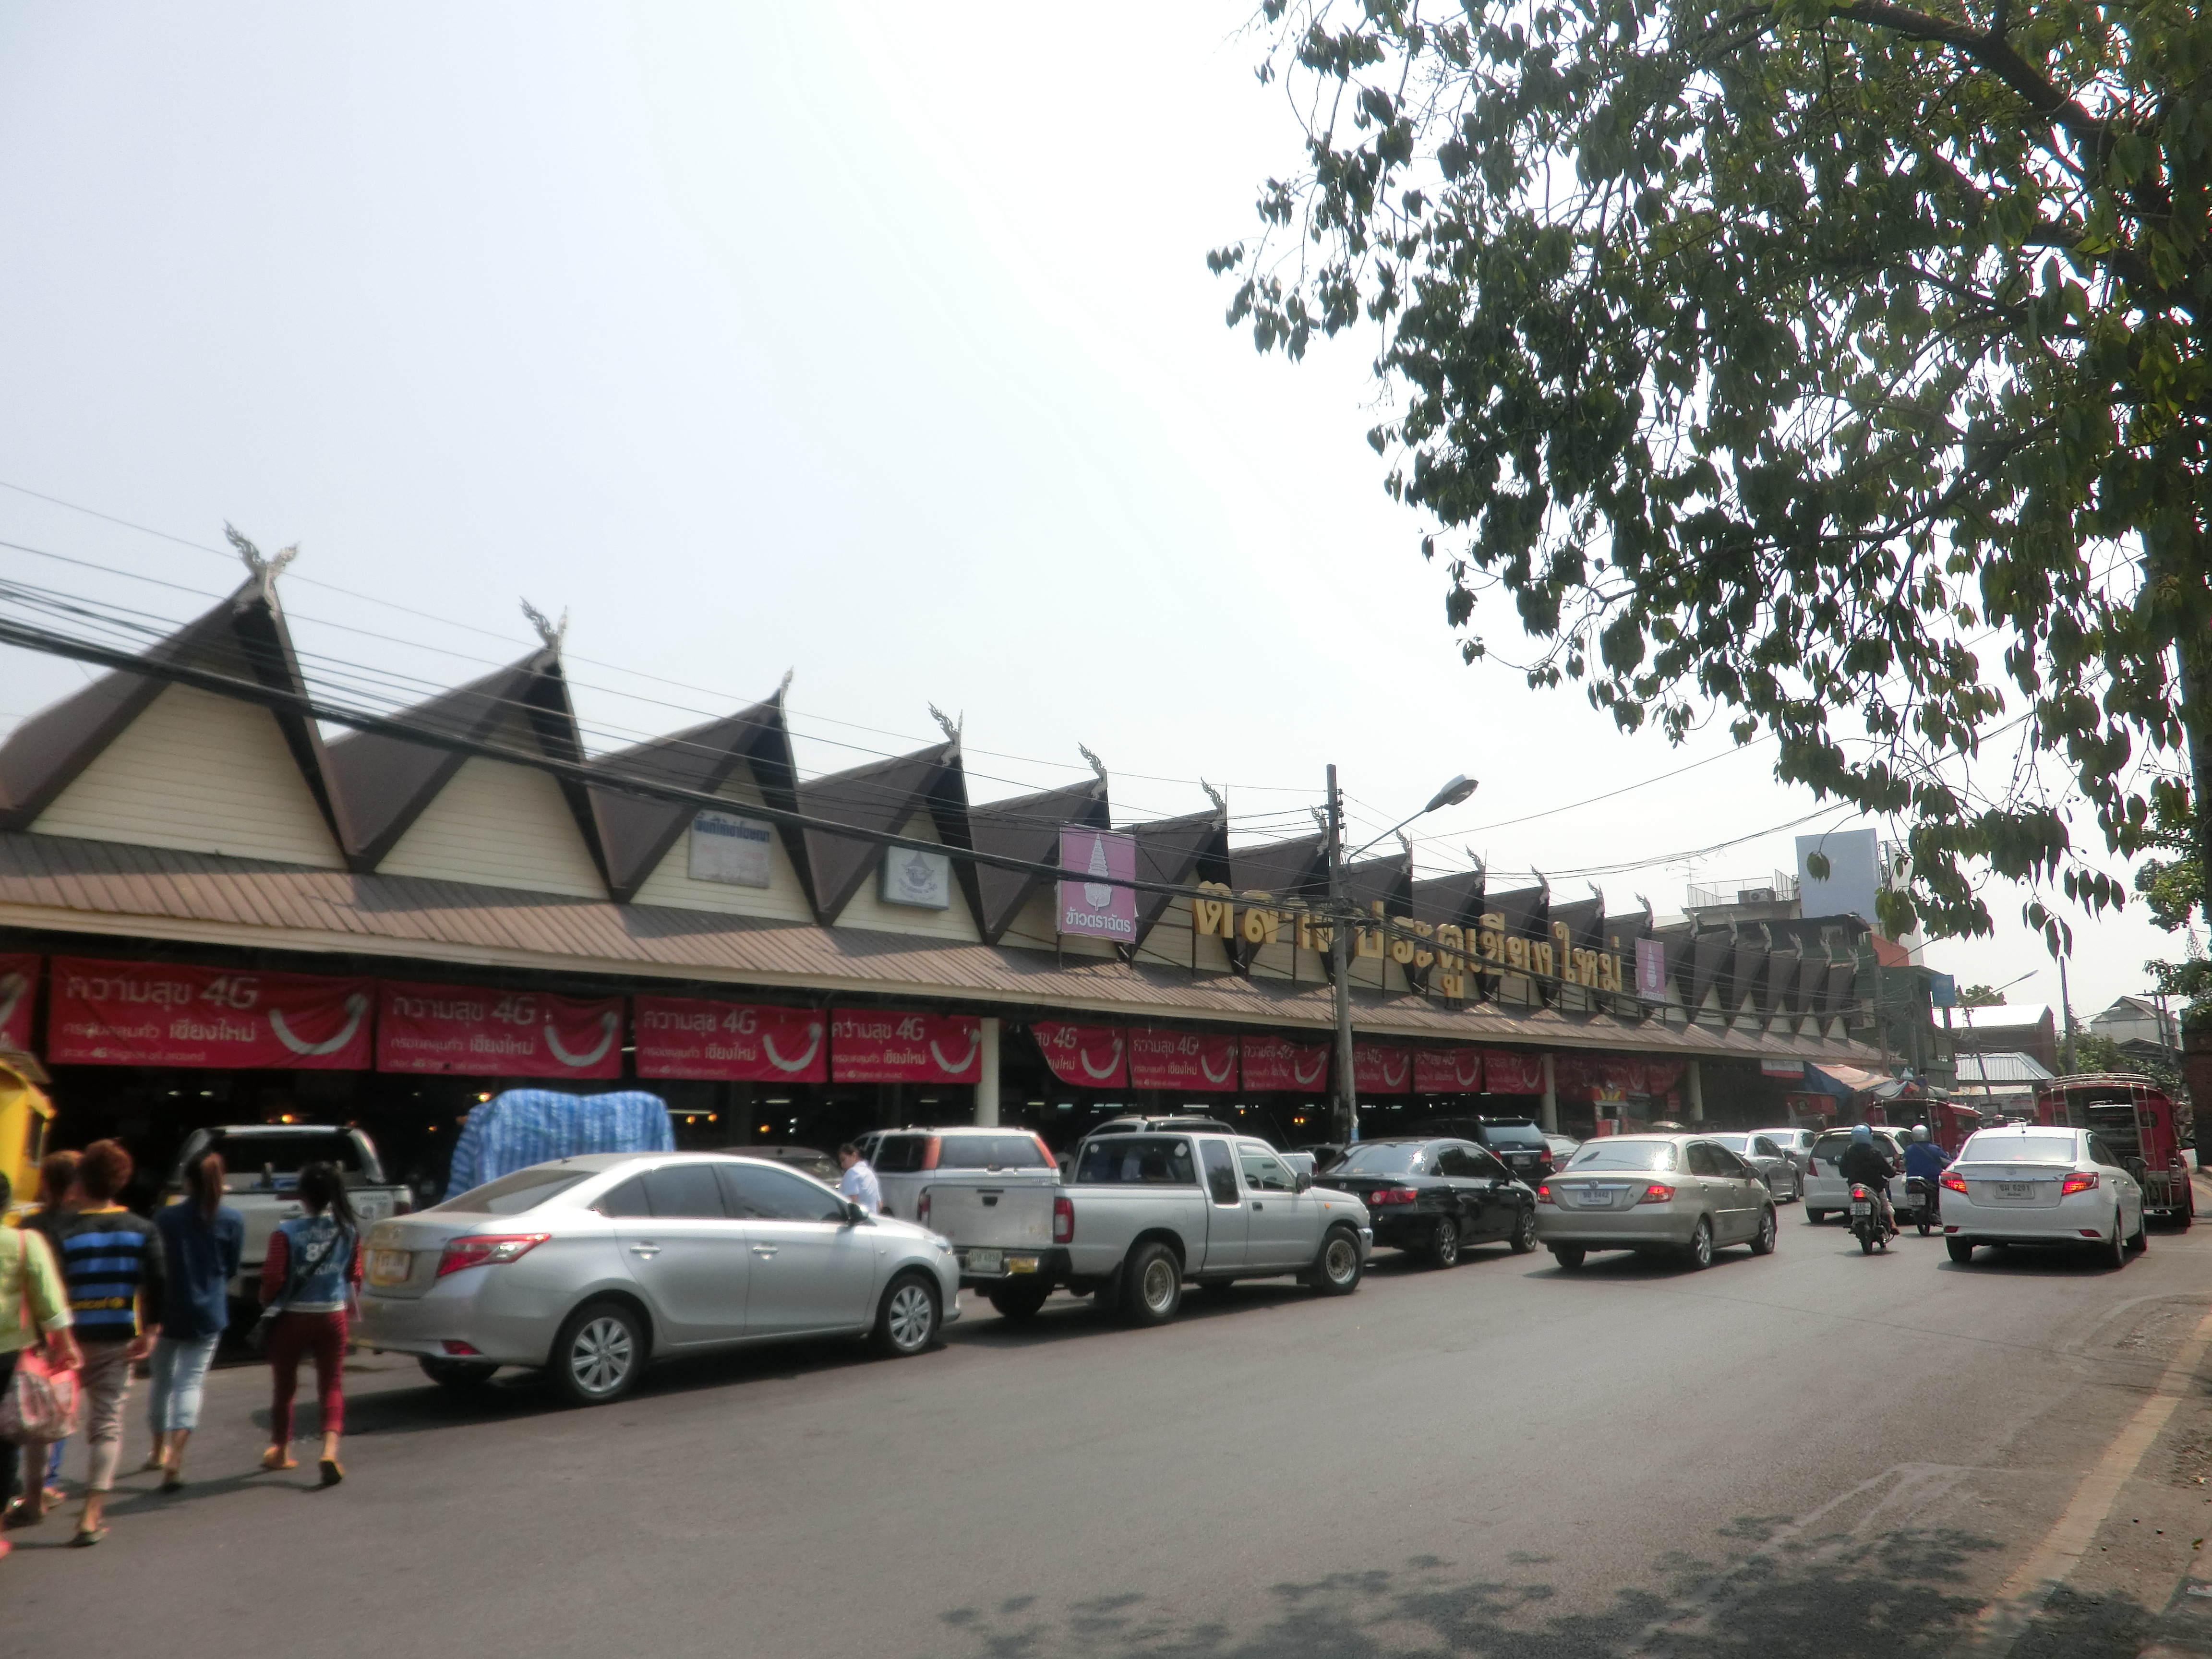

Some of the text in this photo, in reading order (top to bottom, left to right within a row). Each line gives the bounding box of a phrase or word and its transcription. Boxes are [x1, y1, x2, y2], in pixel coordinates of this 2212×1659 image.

[1066, 906, 1131, 934] ข้าวตราฉัตร
[66, 974, 258, 1011] ความสุข 4G
[392, 996, 537, 1027] ความสุข 4G
[643, 1009, 757, 1037] ความสุข 4G
[168, 1018, 255, 1042] เชียงใหม่
[832, 1017, 925, 1045] ความสุข 4G
[1053, 1027, 1077, 1048] 4G
[469, 1034, 535, 1055] เชียงใหม่
[704, 1043, 756, 1060] เชียงใหม่
[883, 1048, 926, 1064] เชียงใหม่
[1134, 1035, 1198, 1059] ความสุข 4G
[1167, 1061, 1197, 1076] เชียงใหม่
